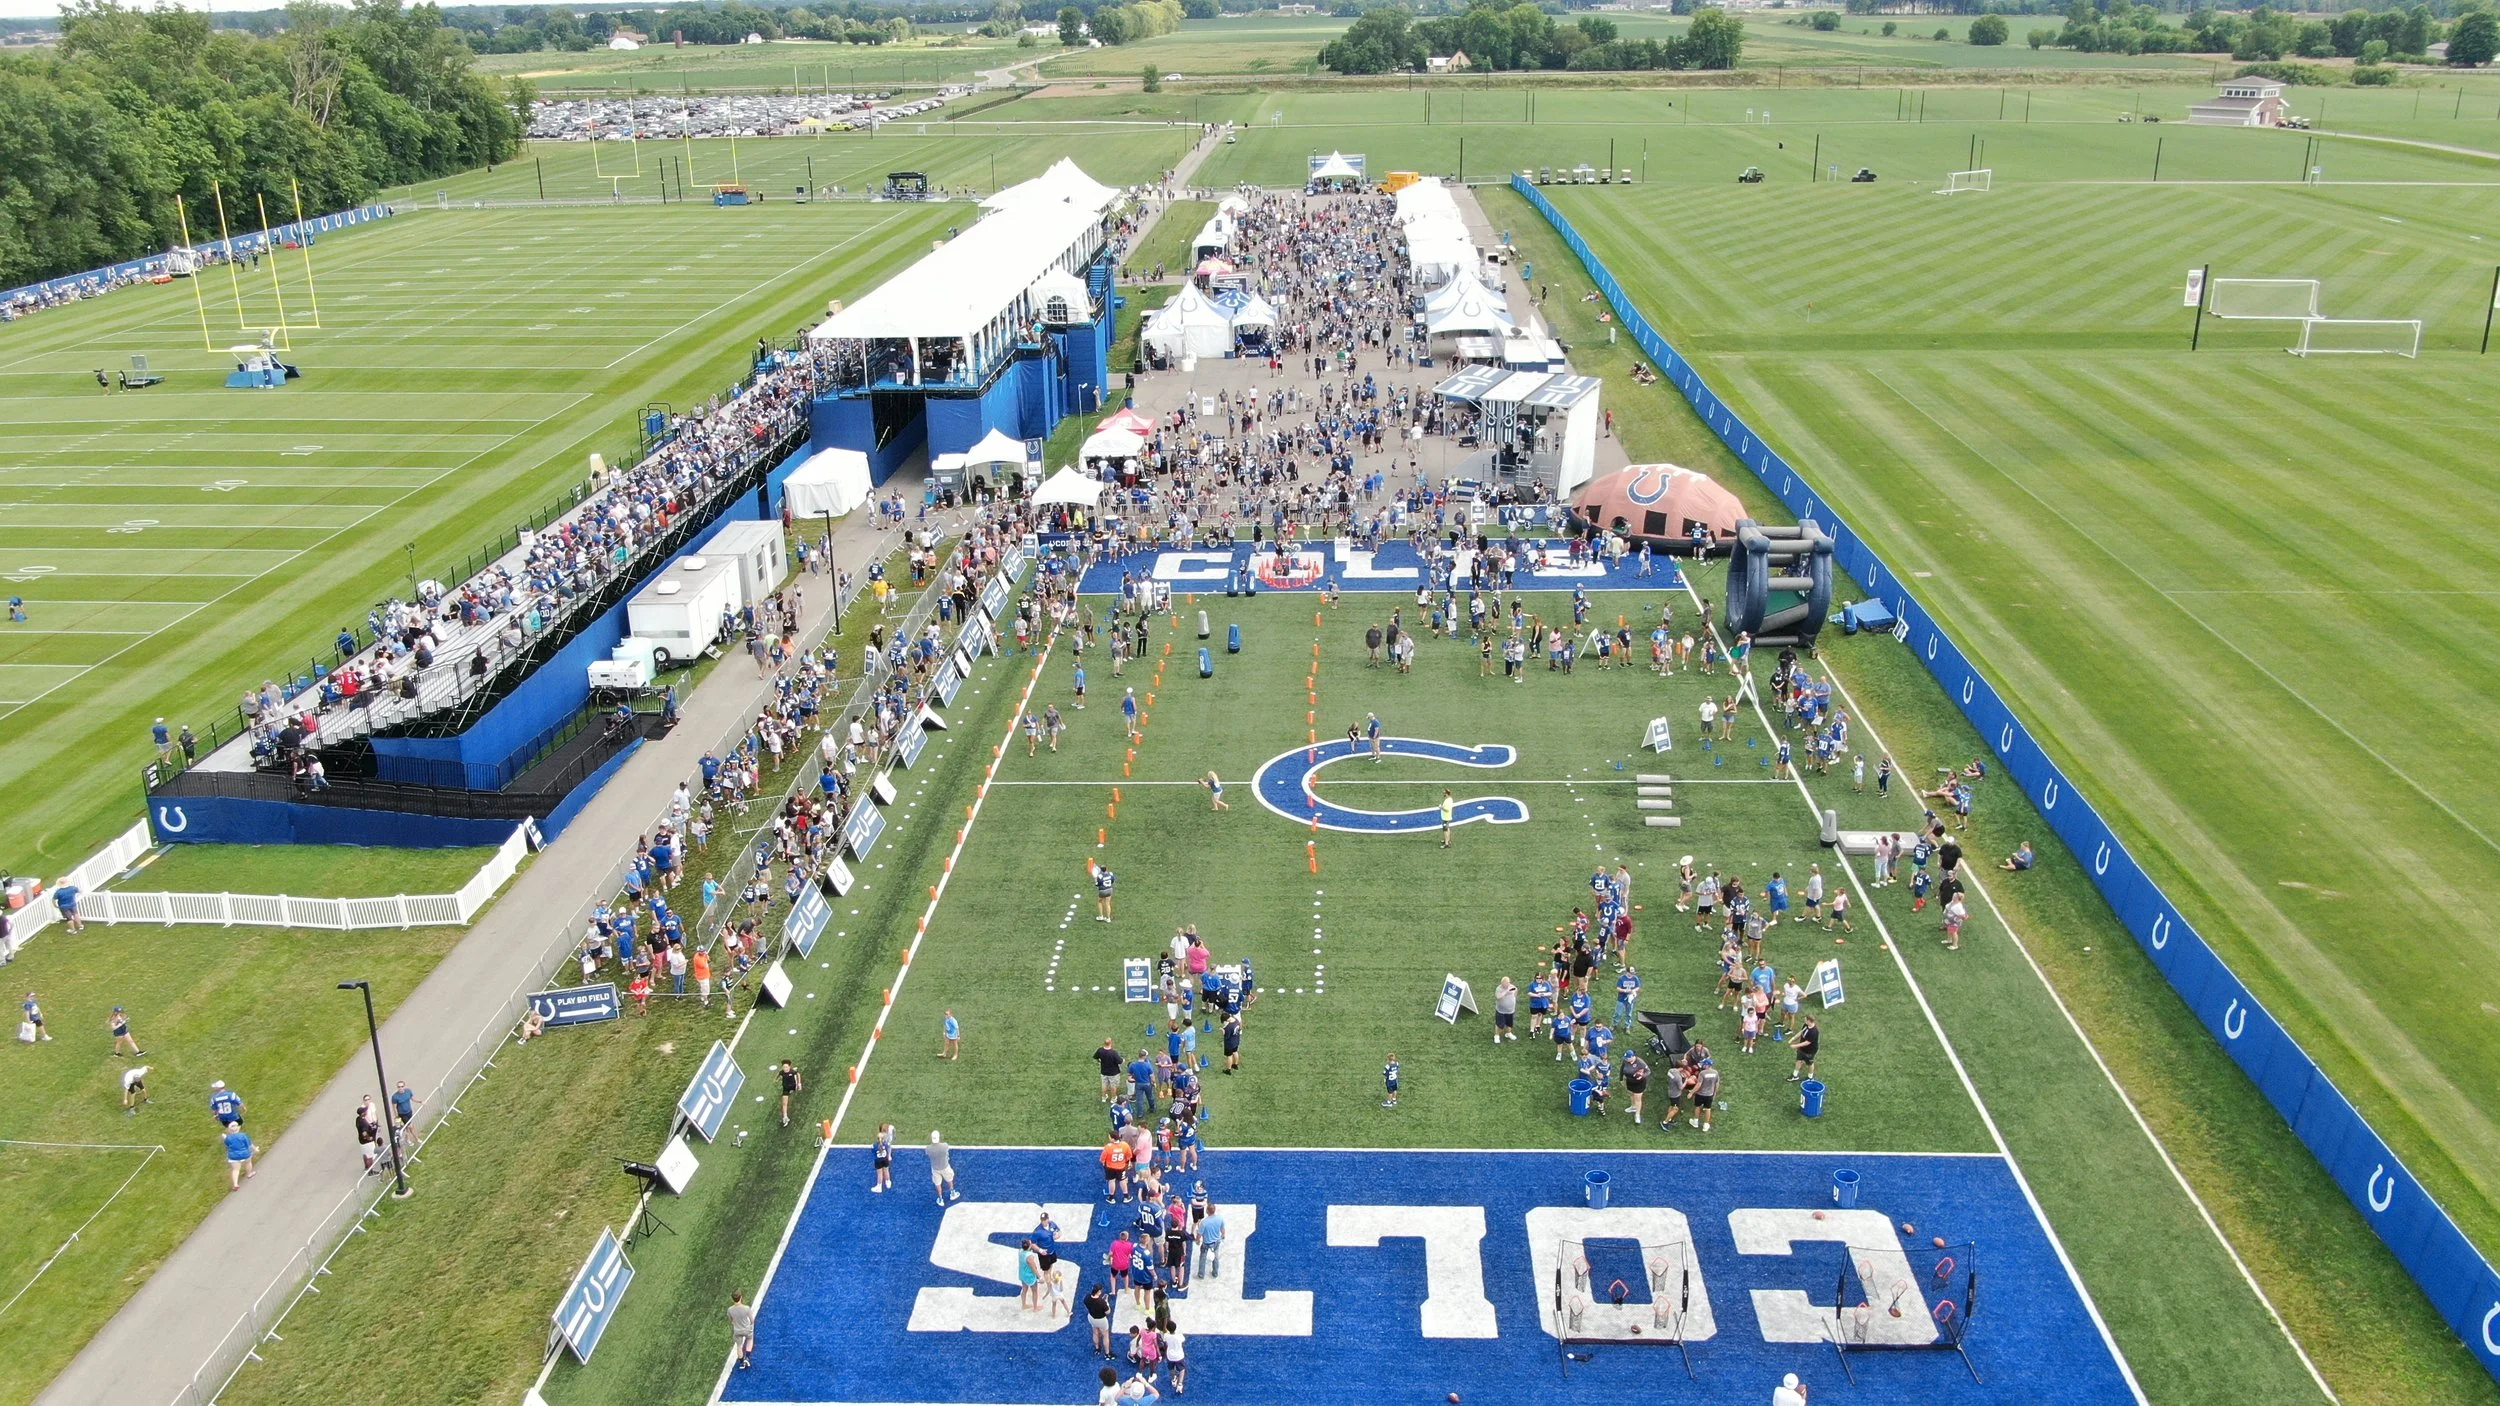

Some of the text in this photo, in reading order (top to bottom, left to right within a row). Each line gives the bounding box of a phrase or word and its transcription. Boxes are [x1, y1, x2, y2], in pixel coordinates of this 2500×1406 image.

[201, 479, 249, 492] 20
[105, 519, 160, 534] 30
[557, 997, 576, 1006] PLAY
[588, 993, 610, 1002] FIELD
[906, 1202, 1940, 1342] COLTS
